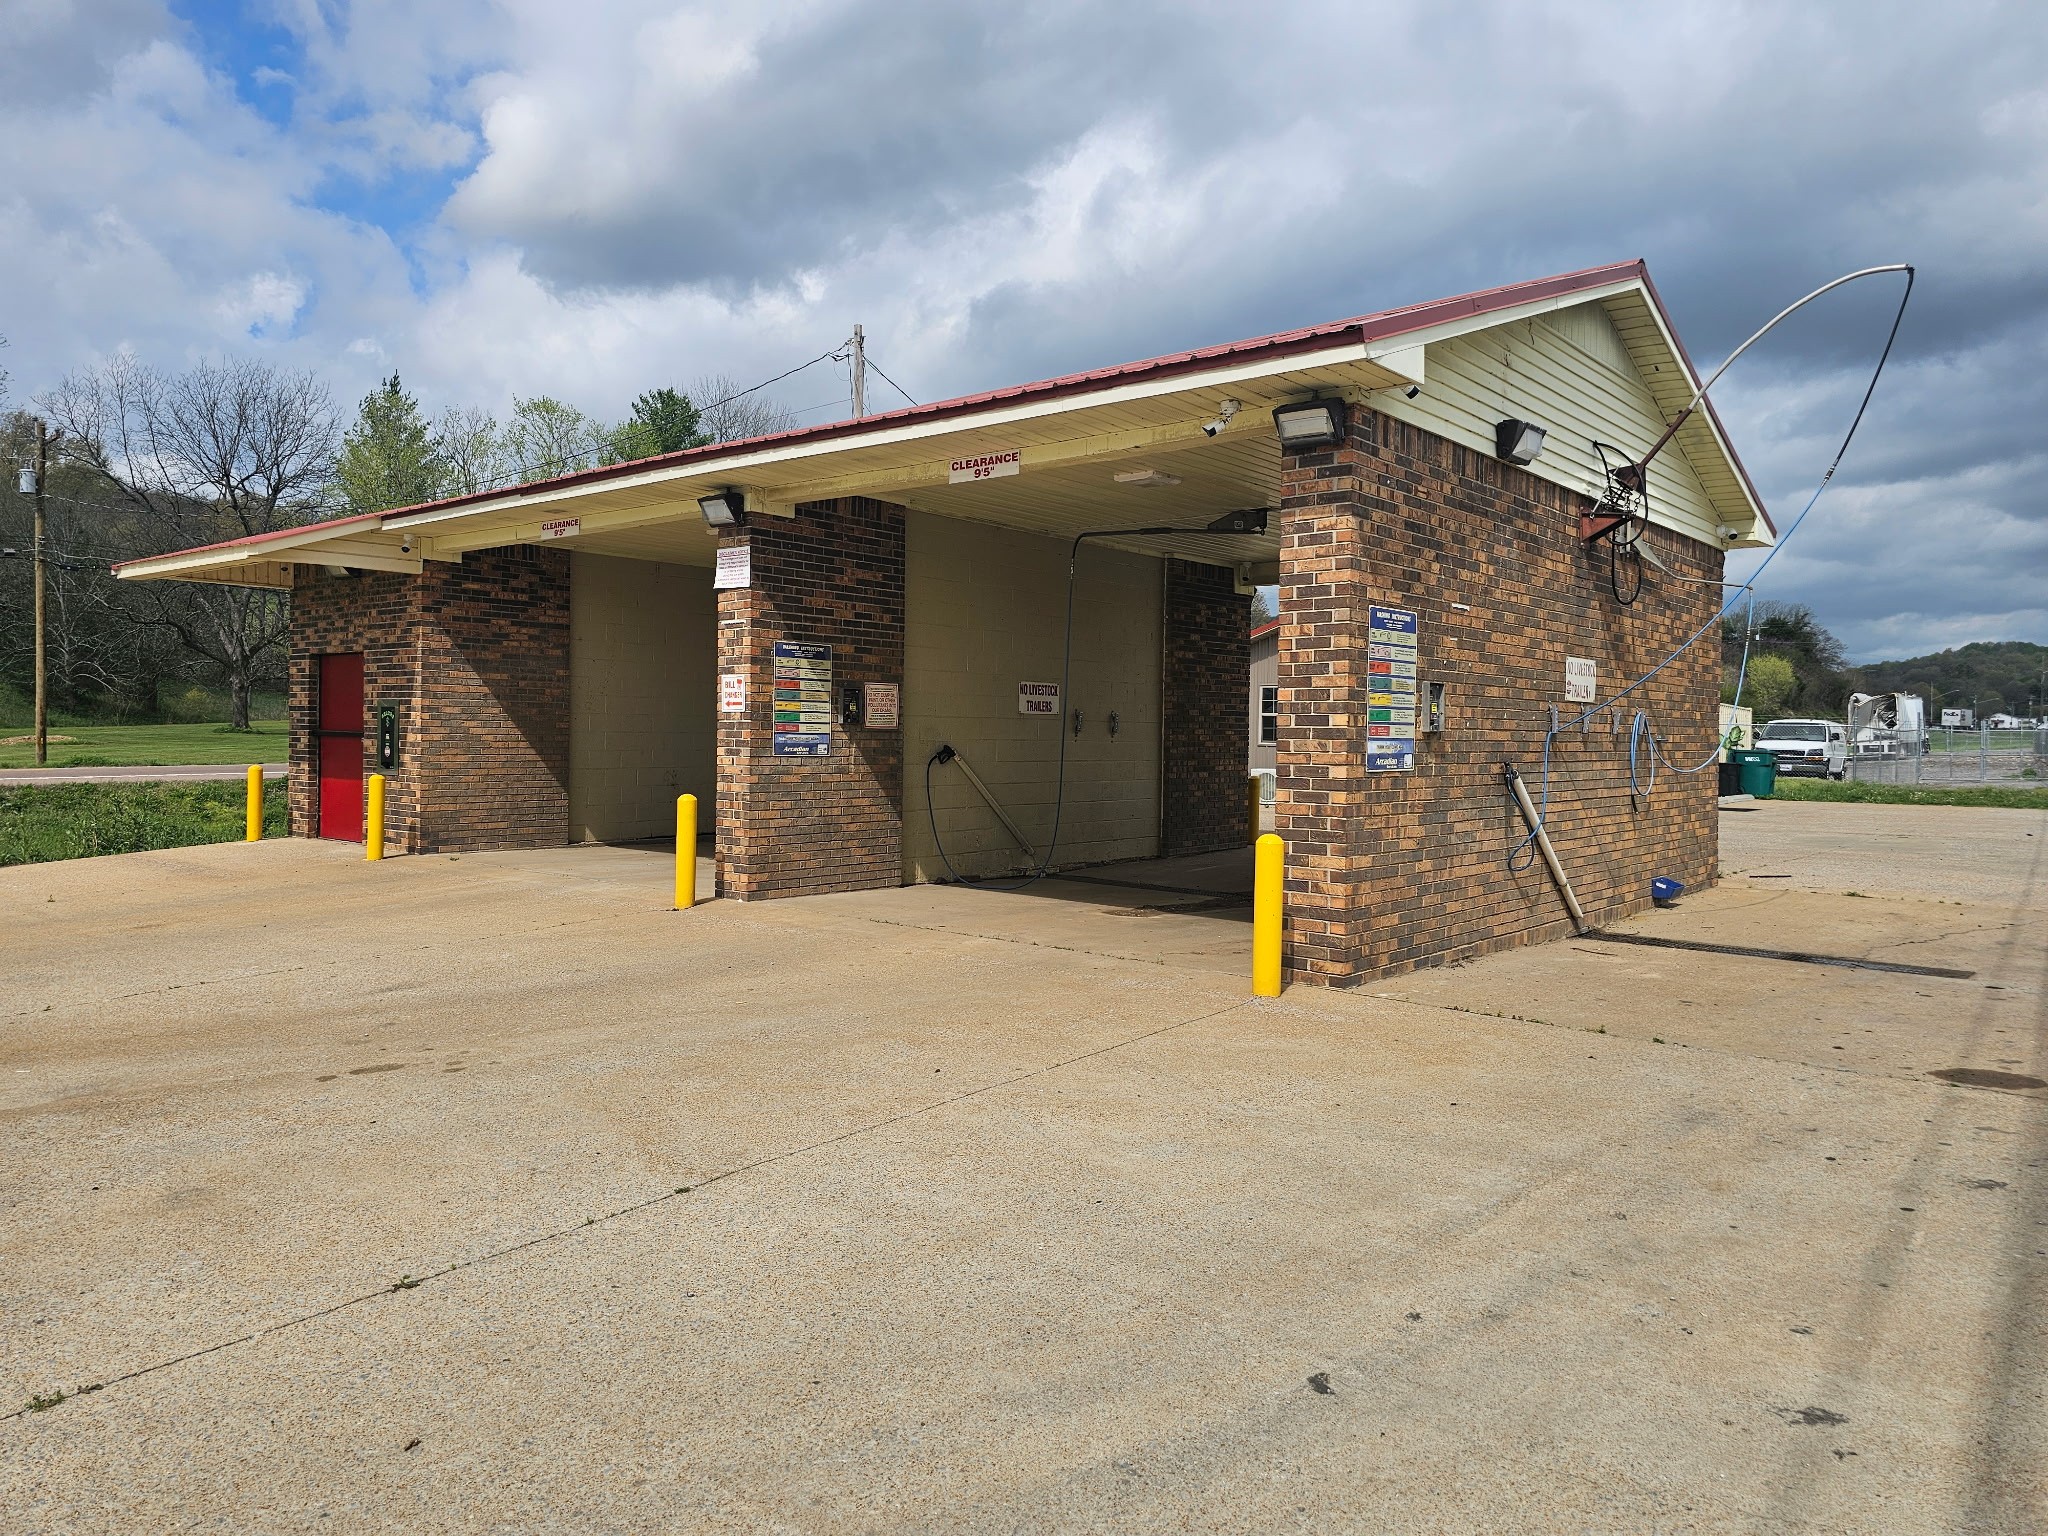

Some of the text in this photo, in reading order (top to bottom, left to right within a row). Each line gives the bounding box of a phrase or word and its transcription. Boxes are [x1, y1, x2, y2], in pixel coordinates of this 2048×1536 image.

[951, 452, 1019, 471] CLEARANCE
[974, 466, 995, 478] 9'5"
[542, 519, 579, 530] CLEARANCE
[725, 681, 736, 689] BILL
[1020, 684, 1058, 697] NO LIVESTOCK
[1027, 700, 1052, 712] TRAILERS
[1375, 757, 1398, 765] Arcadian
